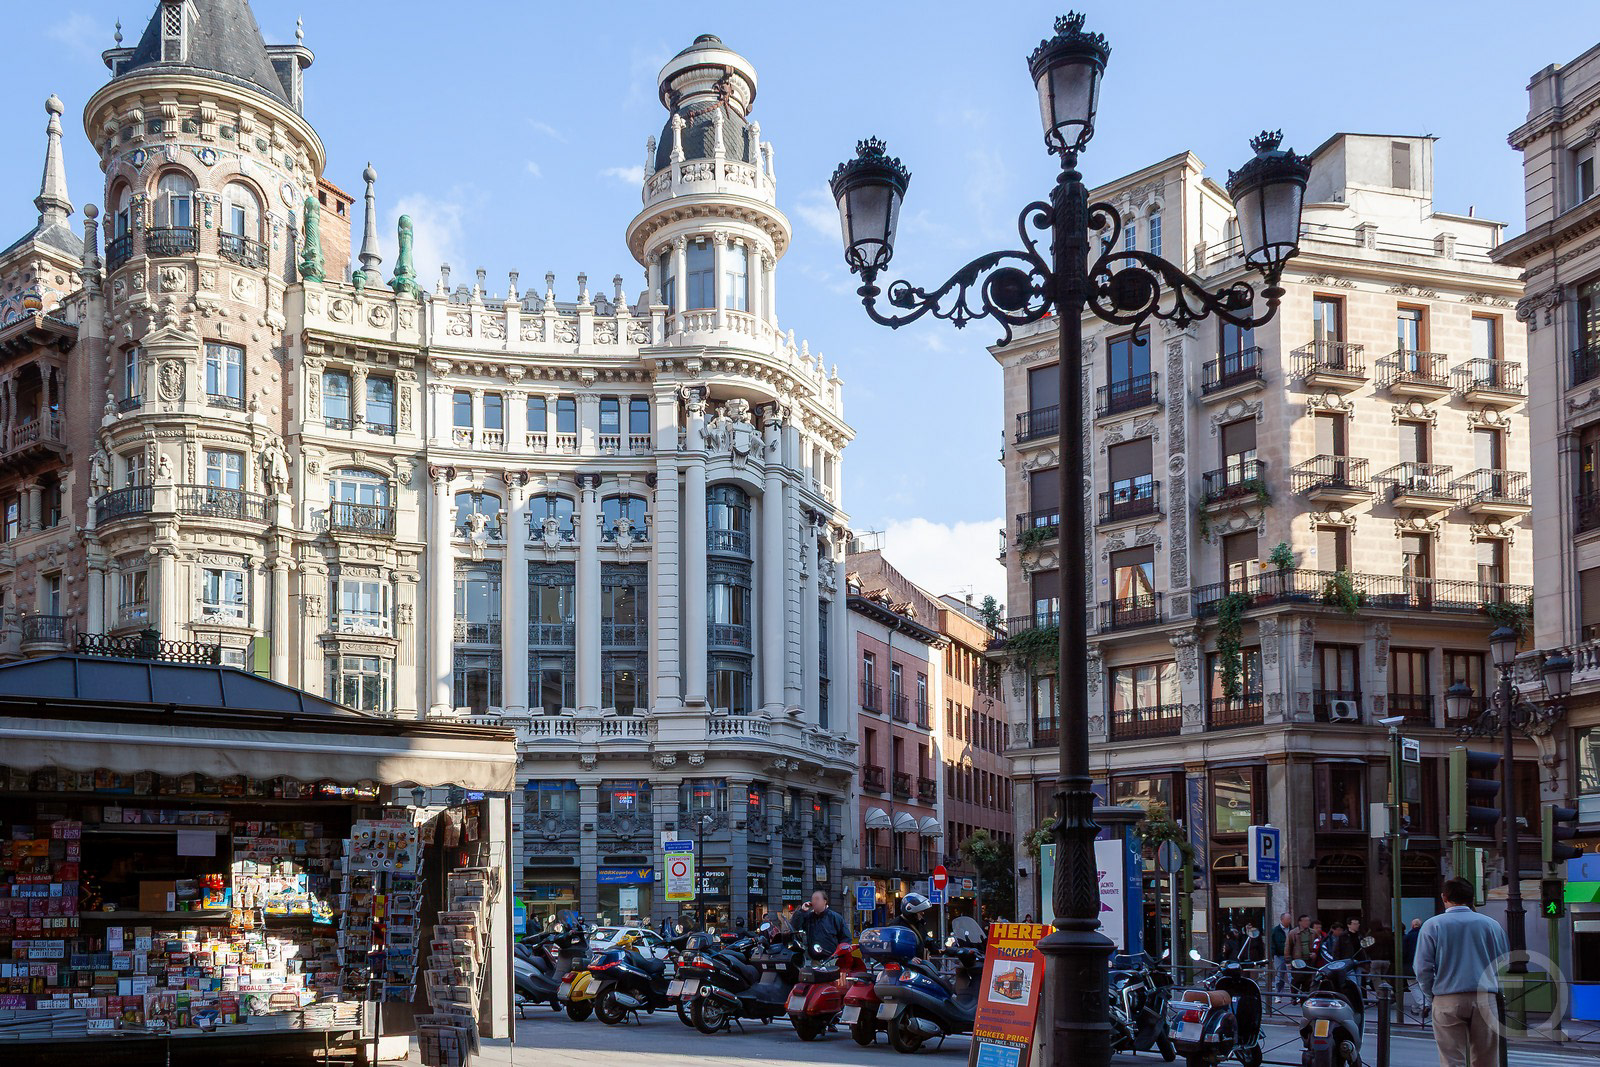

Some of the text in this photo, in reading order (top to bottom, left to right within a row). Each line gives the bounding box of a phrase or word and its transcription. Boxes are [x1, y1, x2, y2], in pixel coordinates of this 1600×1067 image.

[1263, 835, 1273, 856] P
[993, 923, 1042, 939] HERE
[997, 947, 1034, 958] TICKETS
[975, 1029, 1030, 1043] TICKETS PRICE
